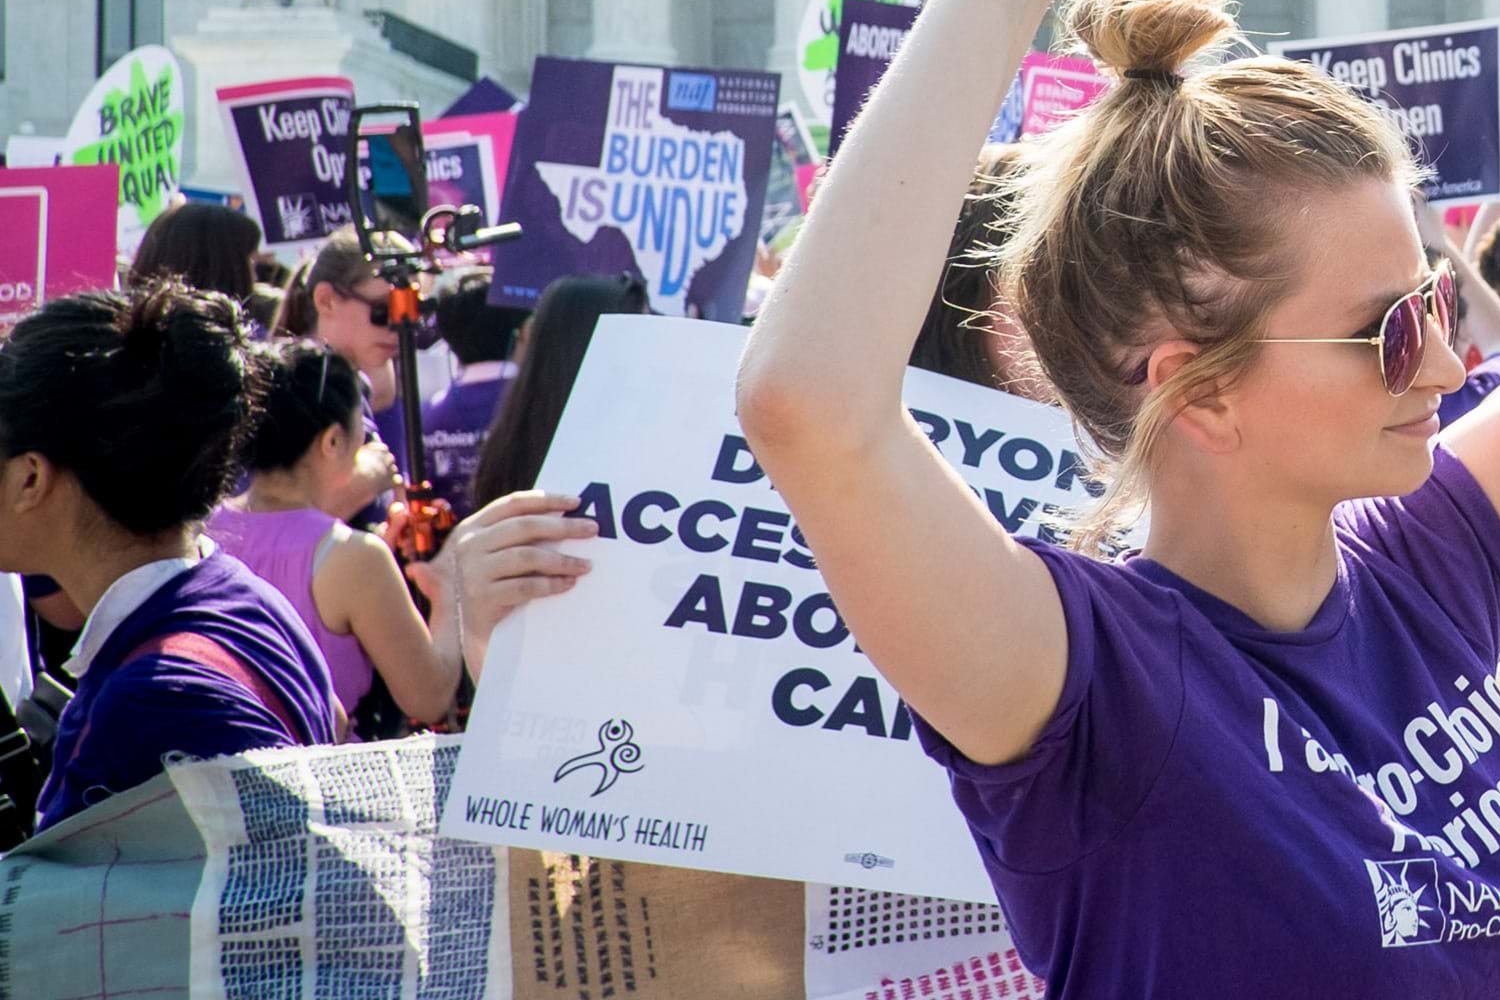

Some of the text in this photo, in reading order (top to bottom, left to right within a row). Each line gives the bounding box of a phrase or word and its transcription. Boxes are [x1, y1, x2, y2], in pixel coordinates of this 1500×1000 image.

[1393, 38, 1482, 85] Clinics
[99, 78, 170, 136] BRAVE
[258, 103, 322, 144] Keep
[614, 80, 657, 129] THE
[98, 120, 175, 165] UNITED
[607, 133, 739, 183] BURDEN
[566, 177, 738, 297] IS UNDUE
[1263, 698, 1283, 772] I
[465, 795, 709, 852] WHOLE WOMAN'S HEALTH
